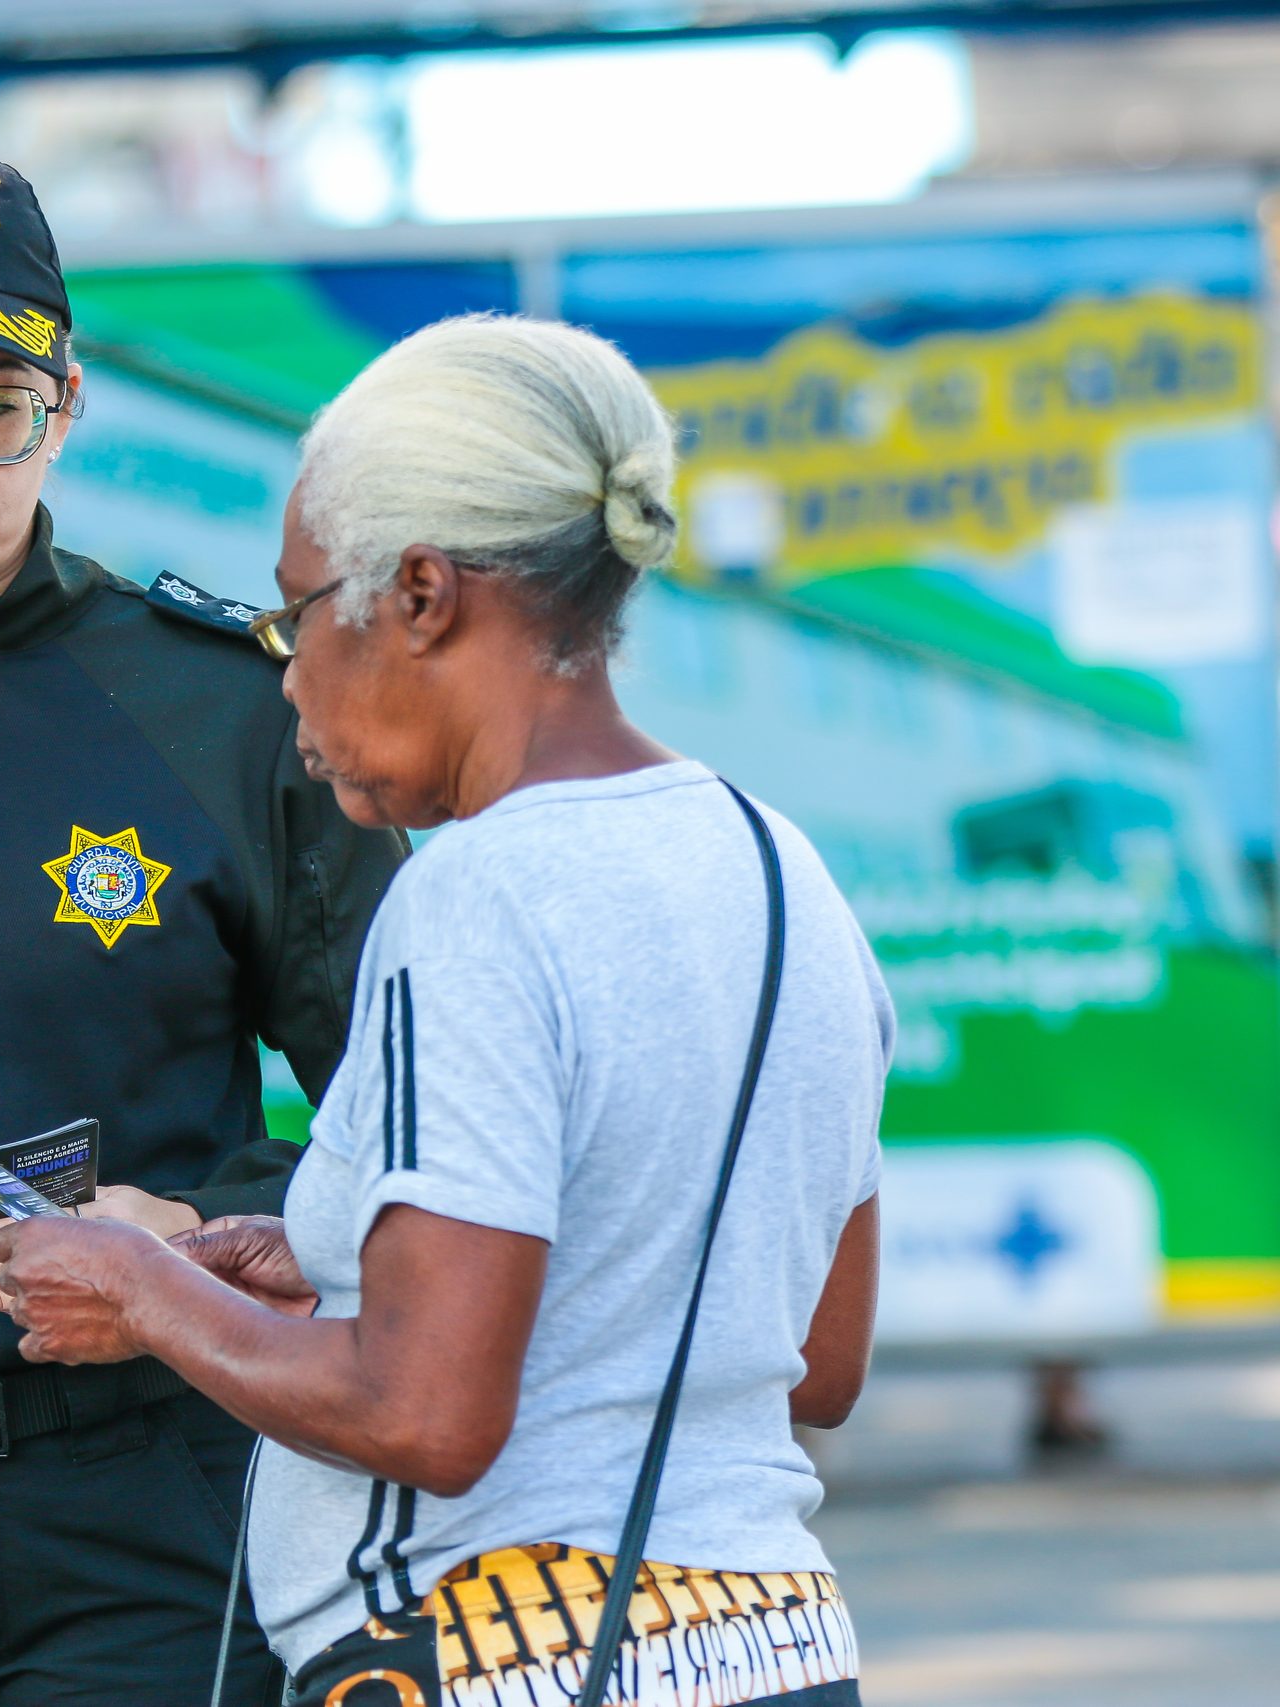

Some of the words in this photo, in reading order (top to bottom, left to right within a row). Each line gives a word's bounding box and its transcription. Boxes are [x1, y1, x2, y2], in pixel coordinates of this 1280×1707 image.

[68, 847, 112, 875] GUARDA
[116, 850, 143, 875] CIVIL
[70, 892, 141, 920] MUNICIPAL
[16, 1158, 42, 1169] ALIADO
[53, 1143, 90, 1159] AGRESSOR.
[67, 1137, 88, 1148] MAIOR
[16, 1150, 90, 1178] DENUNCIE!
